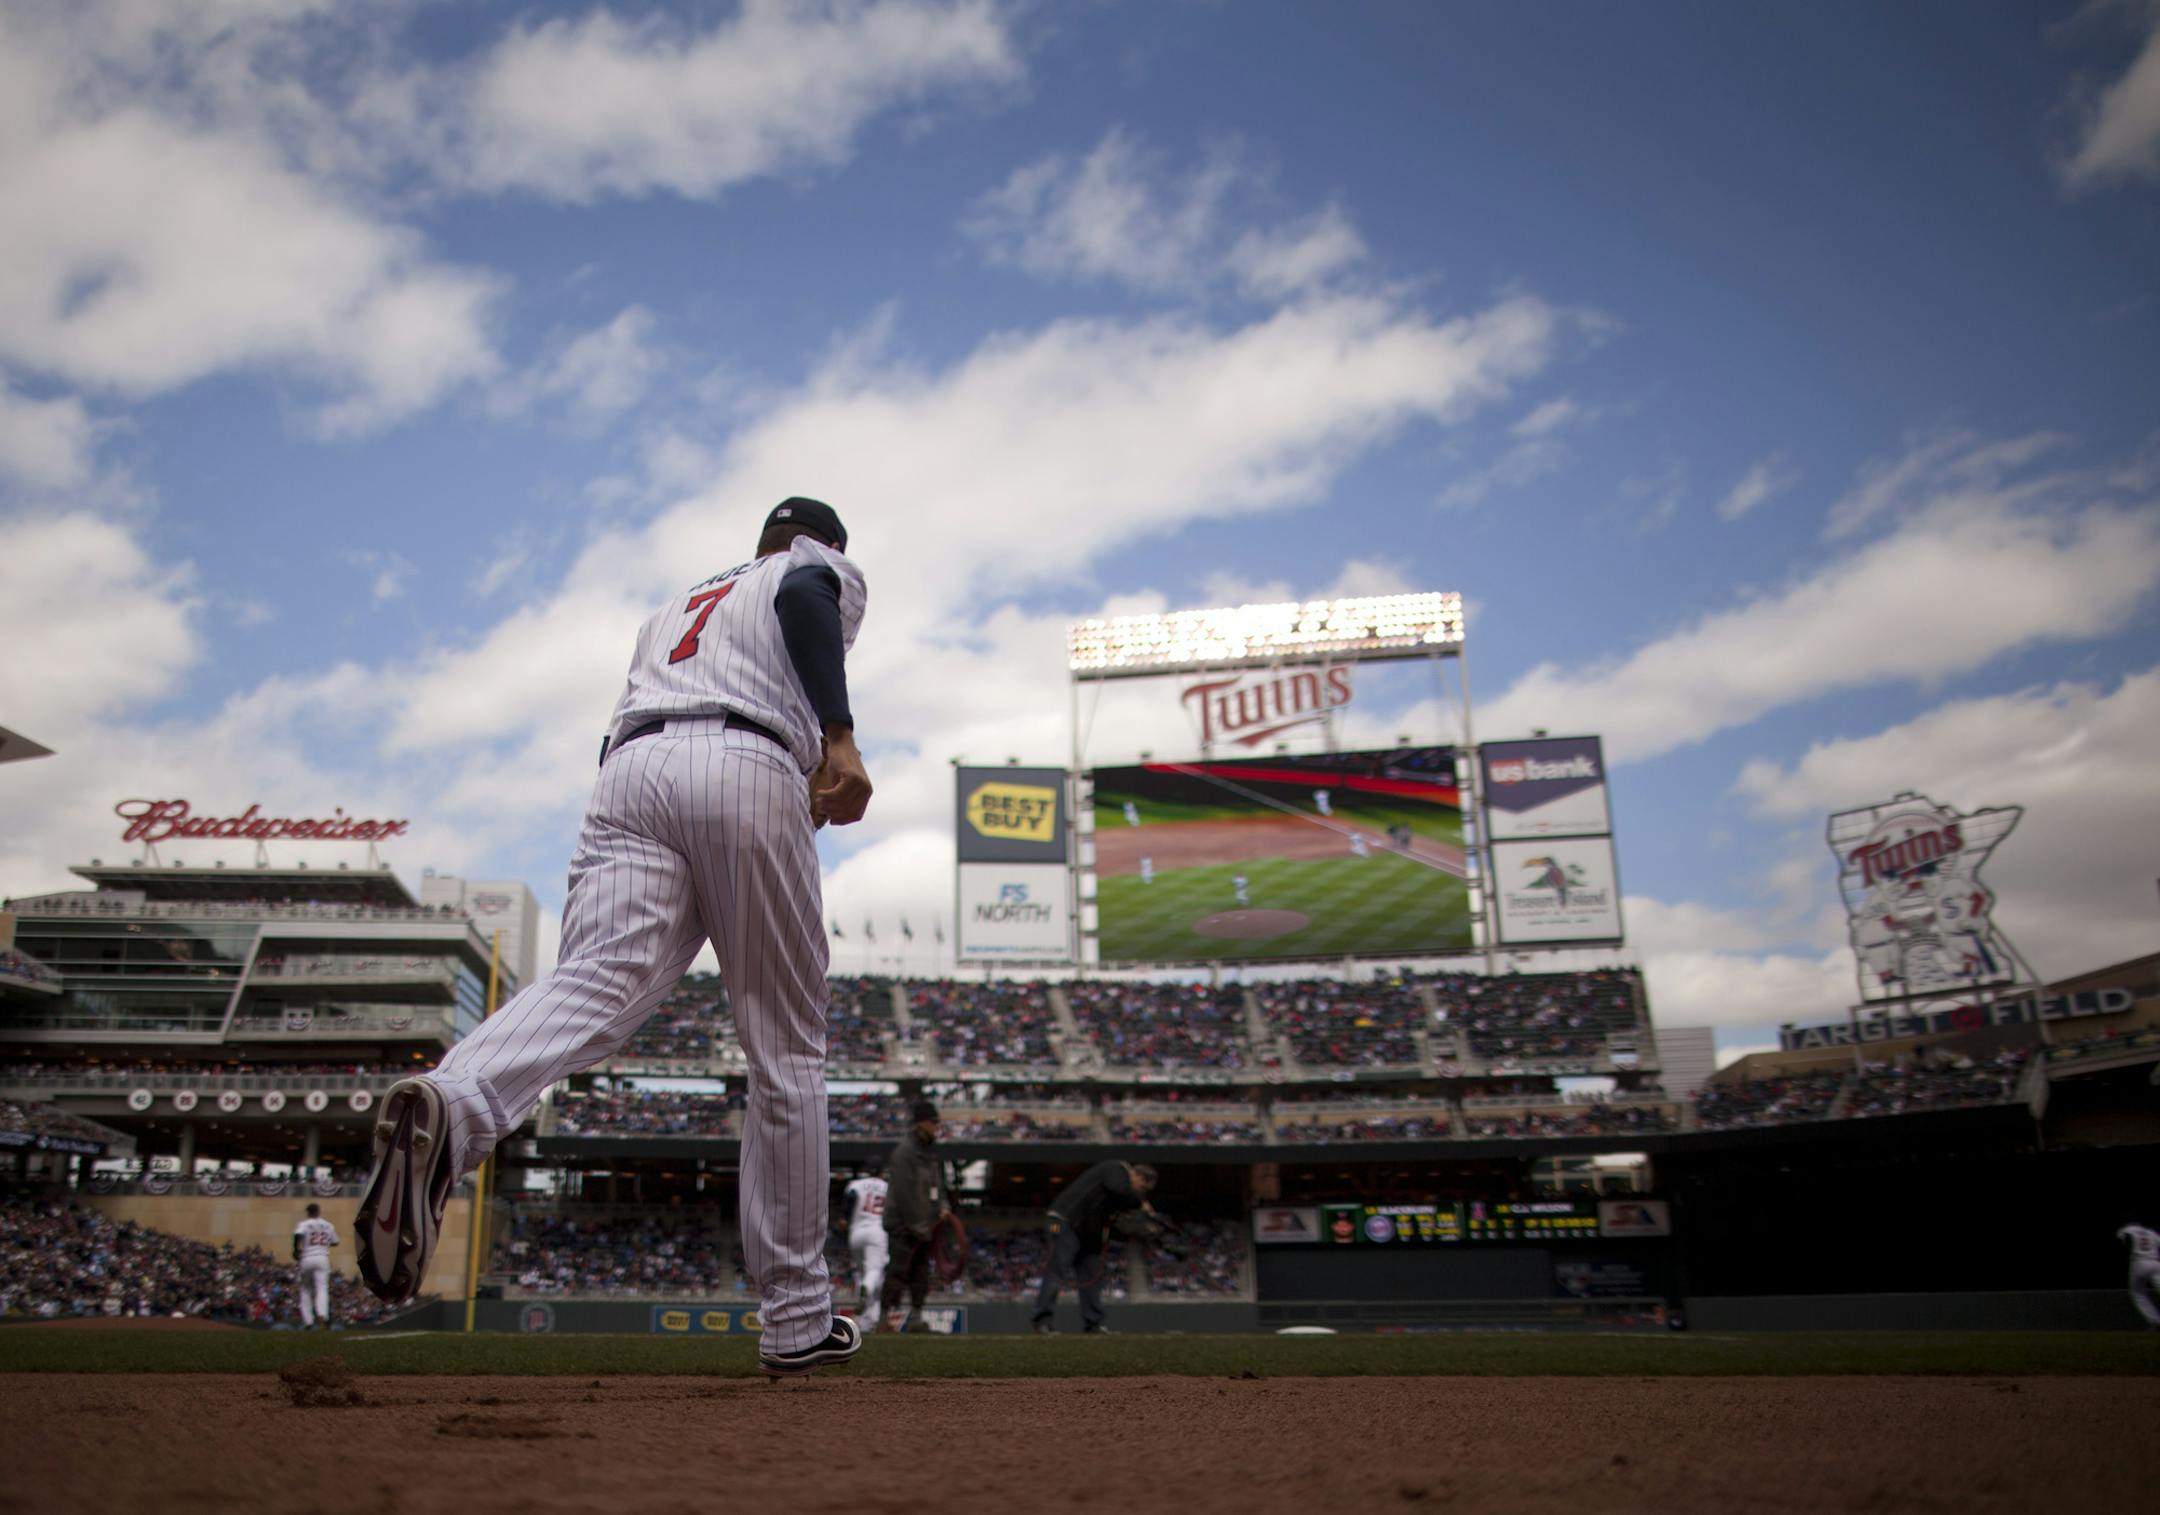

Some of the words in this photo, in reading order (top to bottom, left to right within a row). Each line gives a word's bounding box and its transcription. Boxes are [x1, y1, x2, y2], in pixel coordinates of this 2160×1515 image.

[668, 580, 736, 665] 7
[1182, 664, 1353, 748] Twins
[115, 799, 408, 842] Budweiser
[981, 794, 1050, 815] BEST
[983, 812, 1044, 831] BUY
[1848, 823, 1965, 888] Twins
[976, 903, 1051, 922] NORTH
[1779, 1013, 1943, 1051] TARGET
[1991, 989, 2134, 1026] FIELD
[309, 1231, 329, 1246] 22
